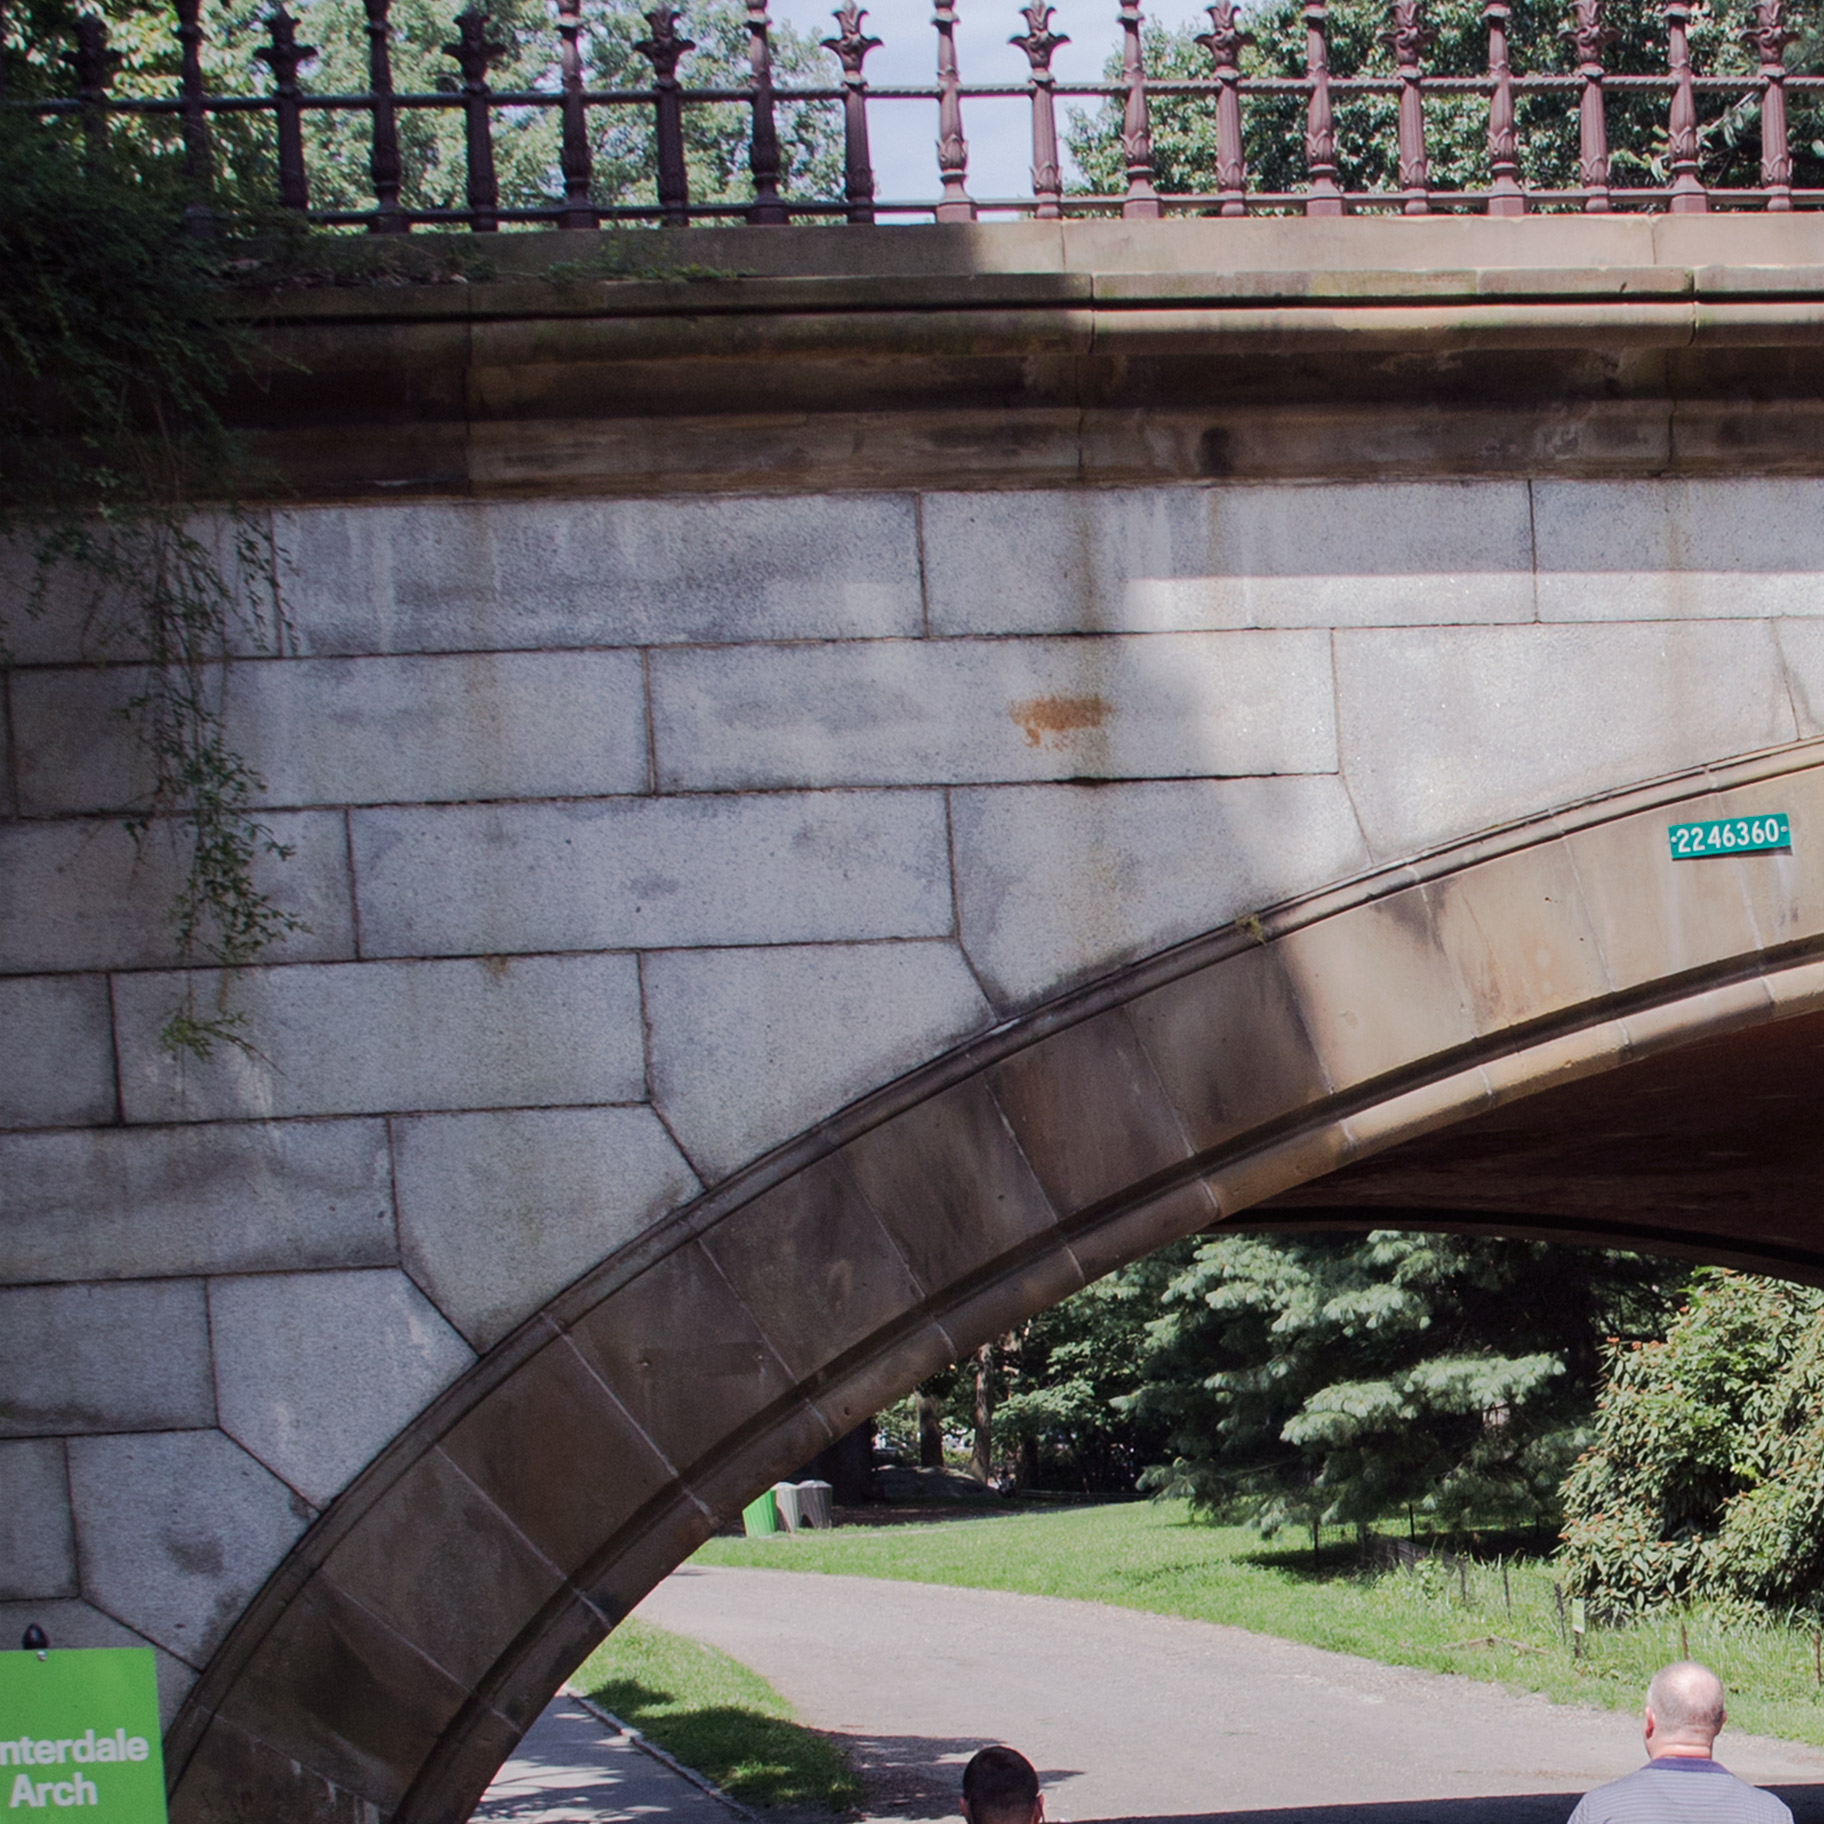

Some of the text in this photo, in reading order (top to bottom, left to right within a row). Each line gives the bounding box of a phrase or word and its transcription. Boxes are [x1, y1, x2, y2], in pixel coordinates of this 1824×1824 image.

[1676, 818, 1779, 853] 2246360
[0, 1729, 149, 1765] nterdale
[9, 1772, 98, 1808] Arch
